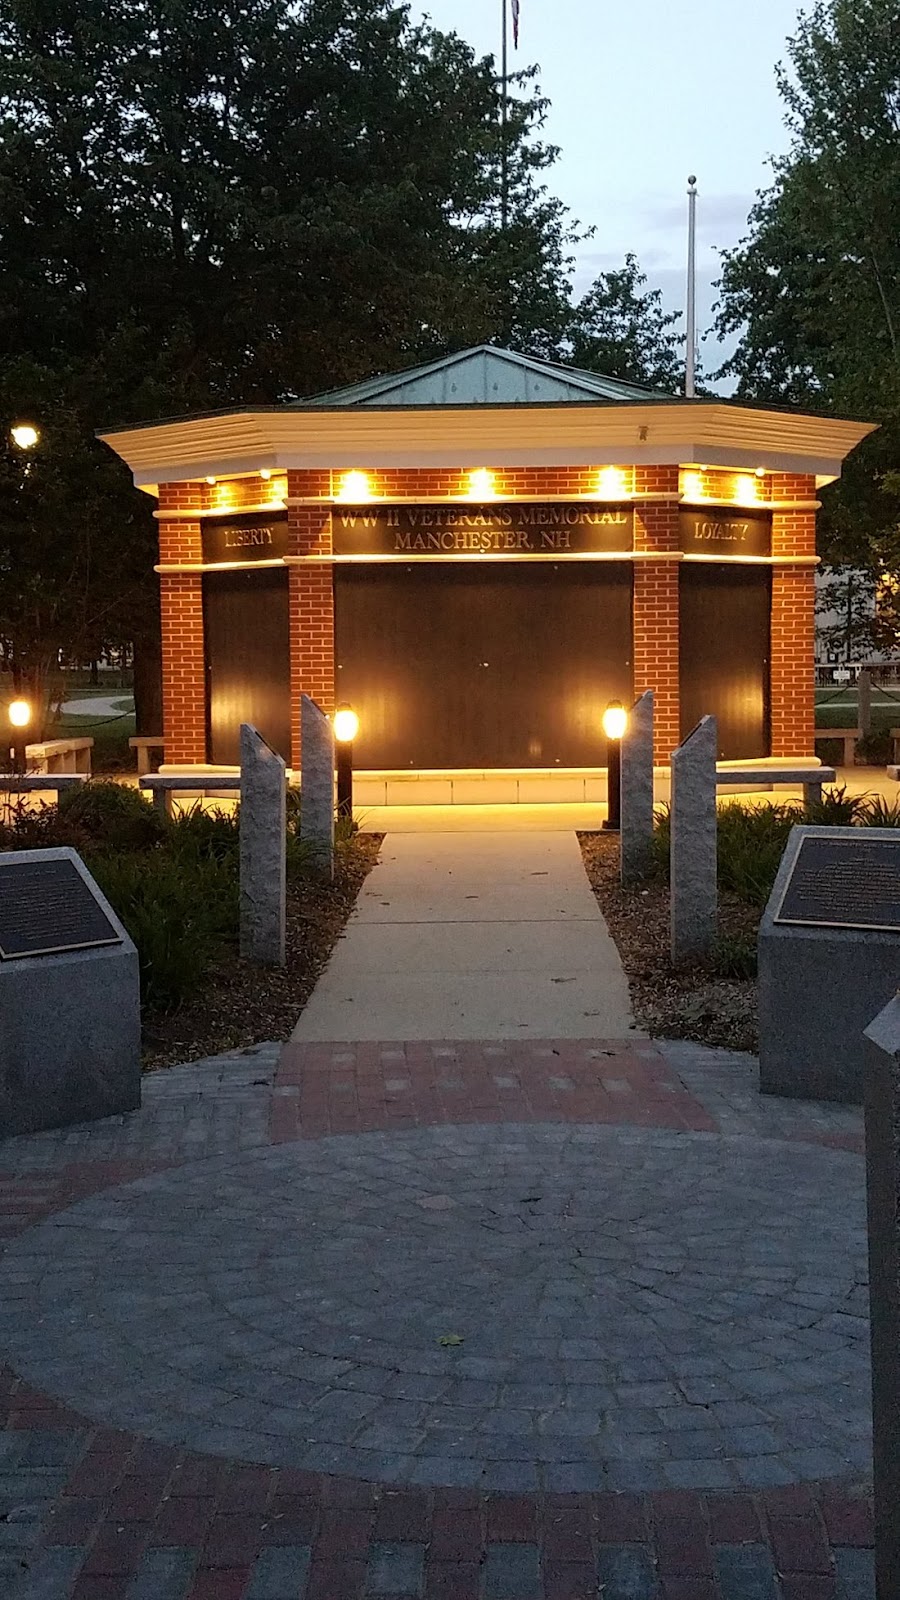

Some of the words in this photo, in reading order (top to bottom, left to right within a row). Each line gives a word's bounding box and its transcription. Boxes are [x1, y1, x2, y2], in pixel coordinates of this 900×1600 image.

[340, 510, 378, 527] WW
[386, 511, 400, 526] II
[406, 509, 512, 526] VETERANS
[518, 507, 628, 525] MEMORIAL
[224, 527, 274, 547] LIBERTY
[394, 531, 534, 550] MANCHESTER,
[540, 531, 571, 548] NH
[694, 522, 748, 540] LOYALTY
